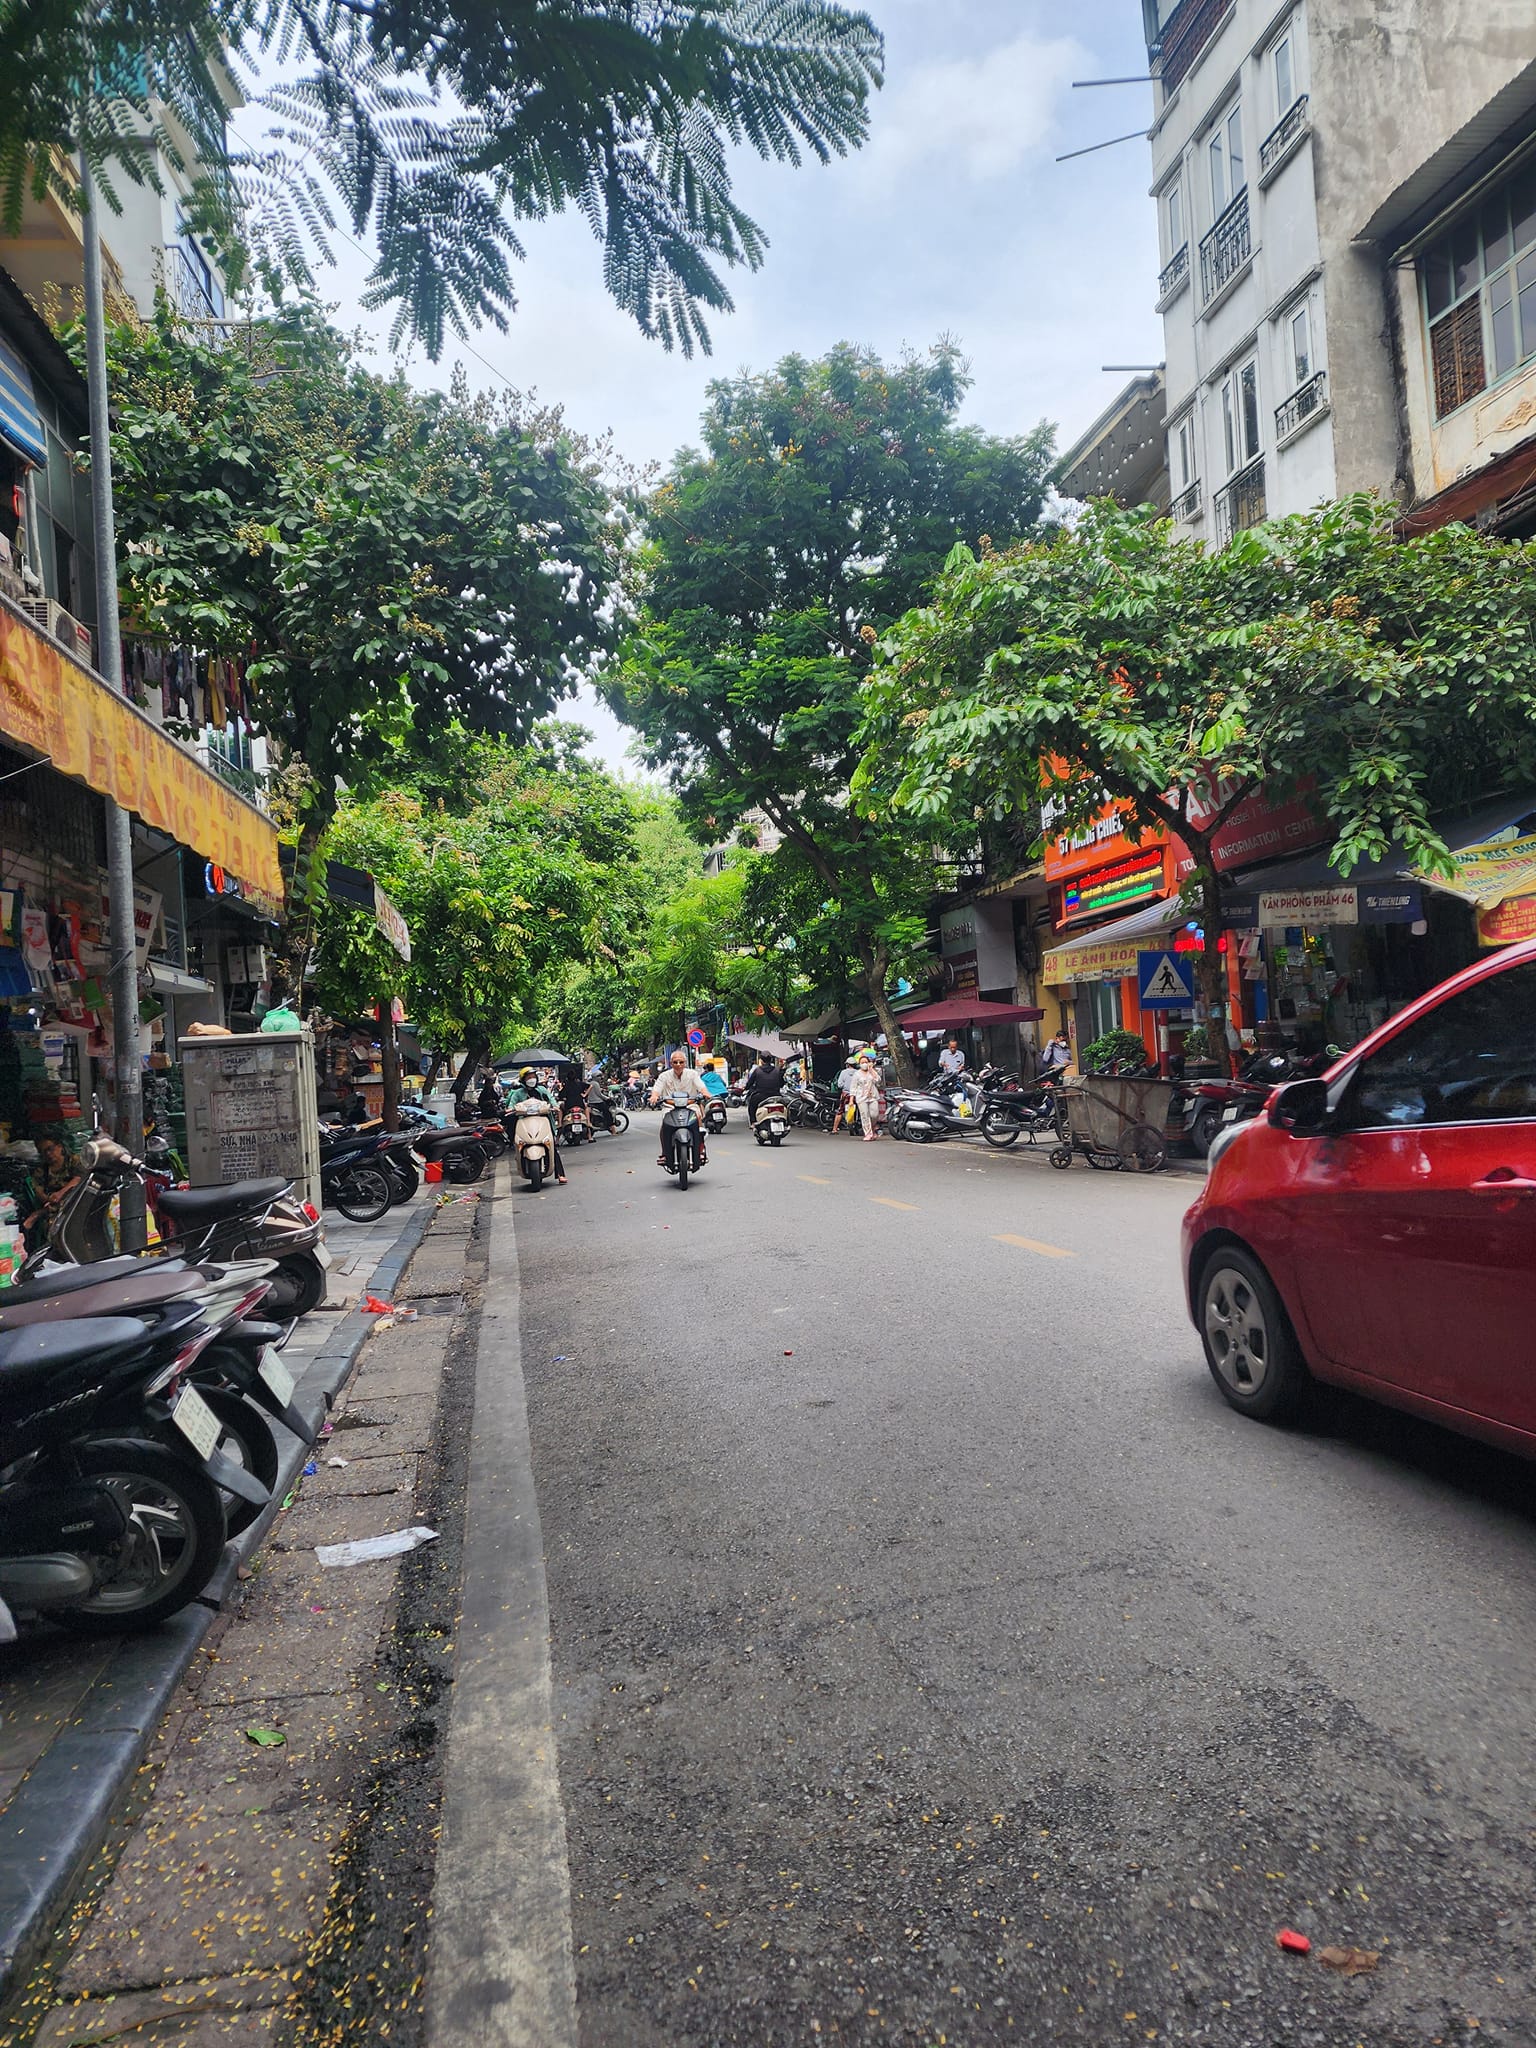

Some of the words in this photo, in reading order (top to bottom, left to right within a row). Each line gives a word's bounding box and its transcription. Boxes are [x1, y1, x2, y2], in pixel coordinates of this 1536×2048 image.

[1059, 836, 1069, 856] 57
[1218, 830, 1280, 859] INFORMATION
[1341, 893, 1354, 905] 46
[1110, 948, 1136, 961] HOA
[1045, 956, 1057, 972] 48
